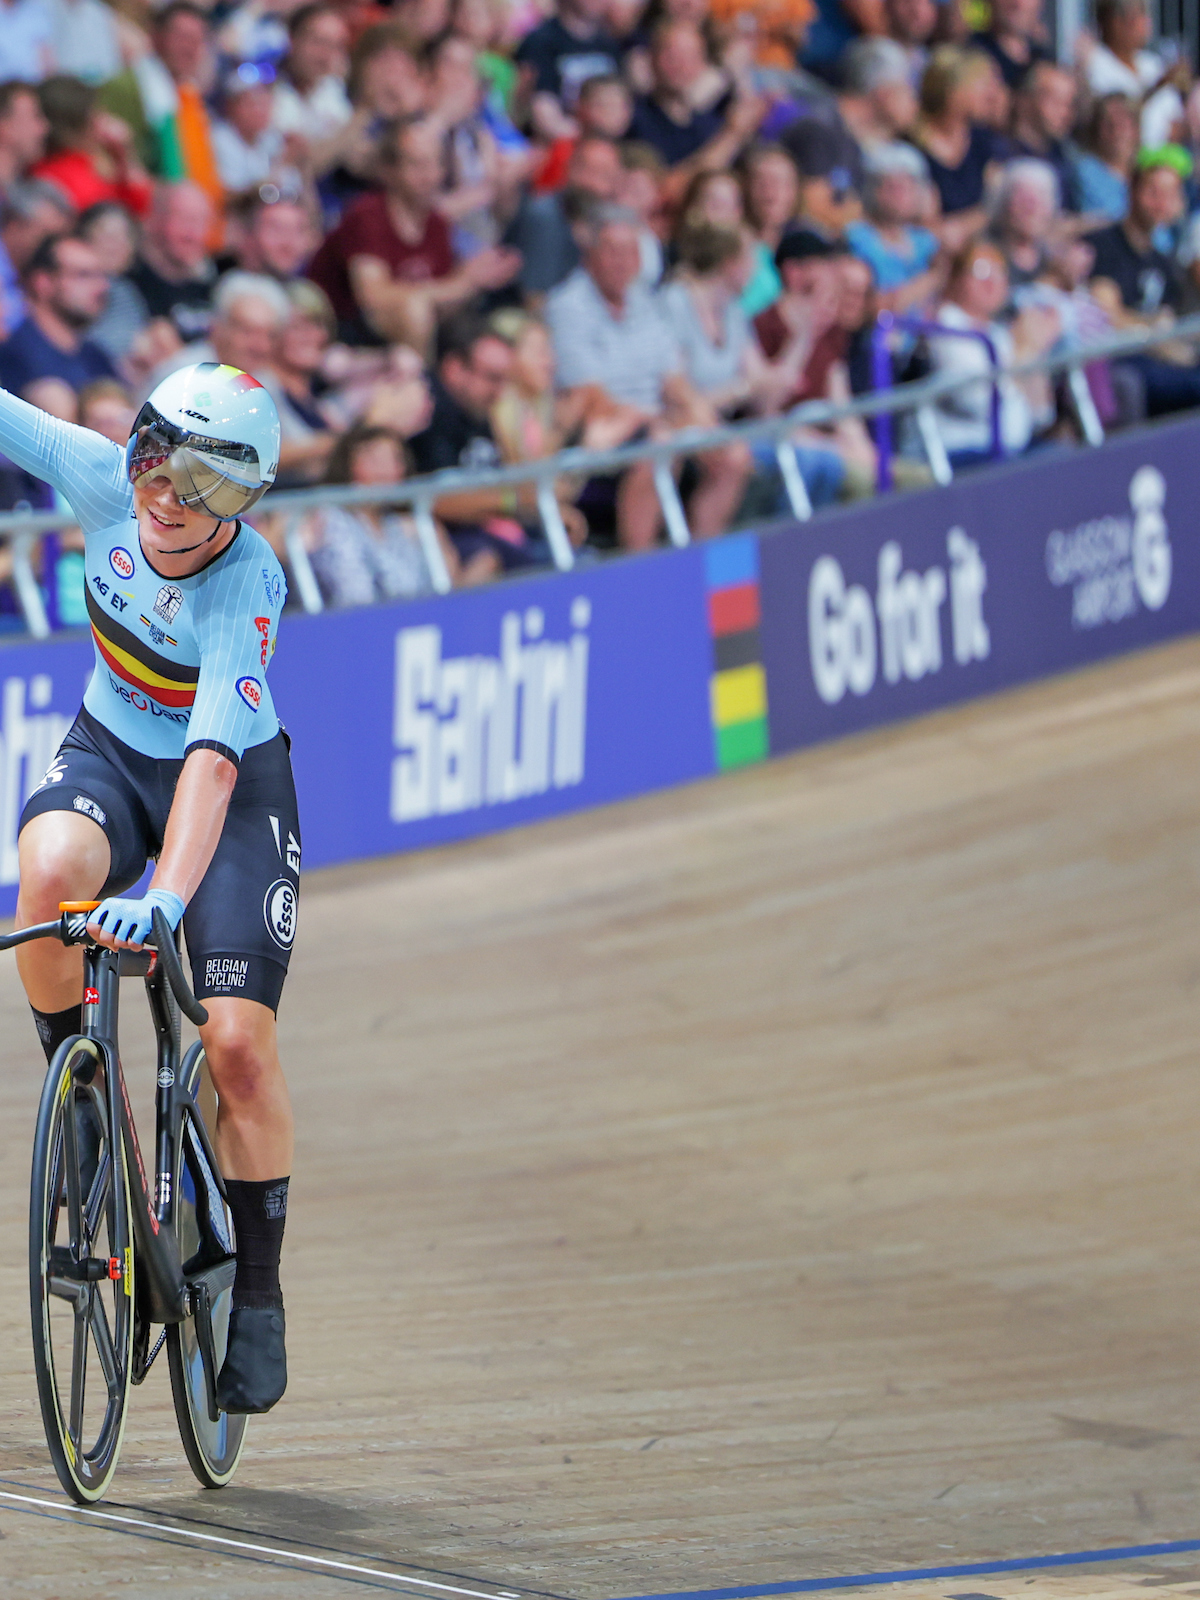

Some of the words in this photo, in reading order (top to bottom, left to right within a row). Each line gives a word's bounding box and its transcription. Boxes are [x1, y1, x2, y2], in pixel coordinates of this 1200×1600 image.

[110, 593, 128, 613] EY
[808, 555, 877, 704] Go
[877, 540, 946, 685] for
[947, 525, 990, 666] it
[254, 616, 270, 672] Lott
[390, 596, 591, 824] Santini
[286, 831, 301, 876] EY
[204, 972, 246, 987] CYCLING
[205, 958, 249, 974] BELGIAN
